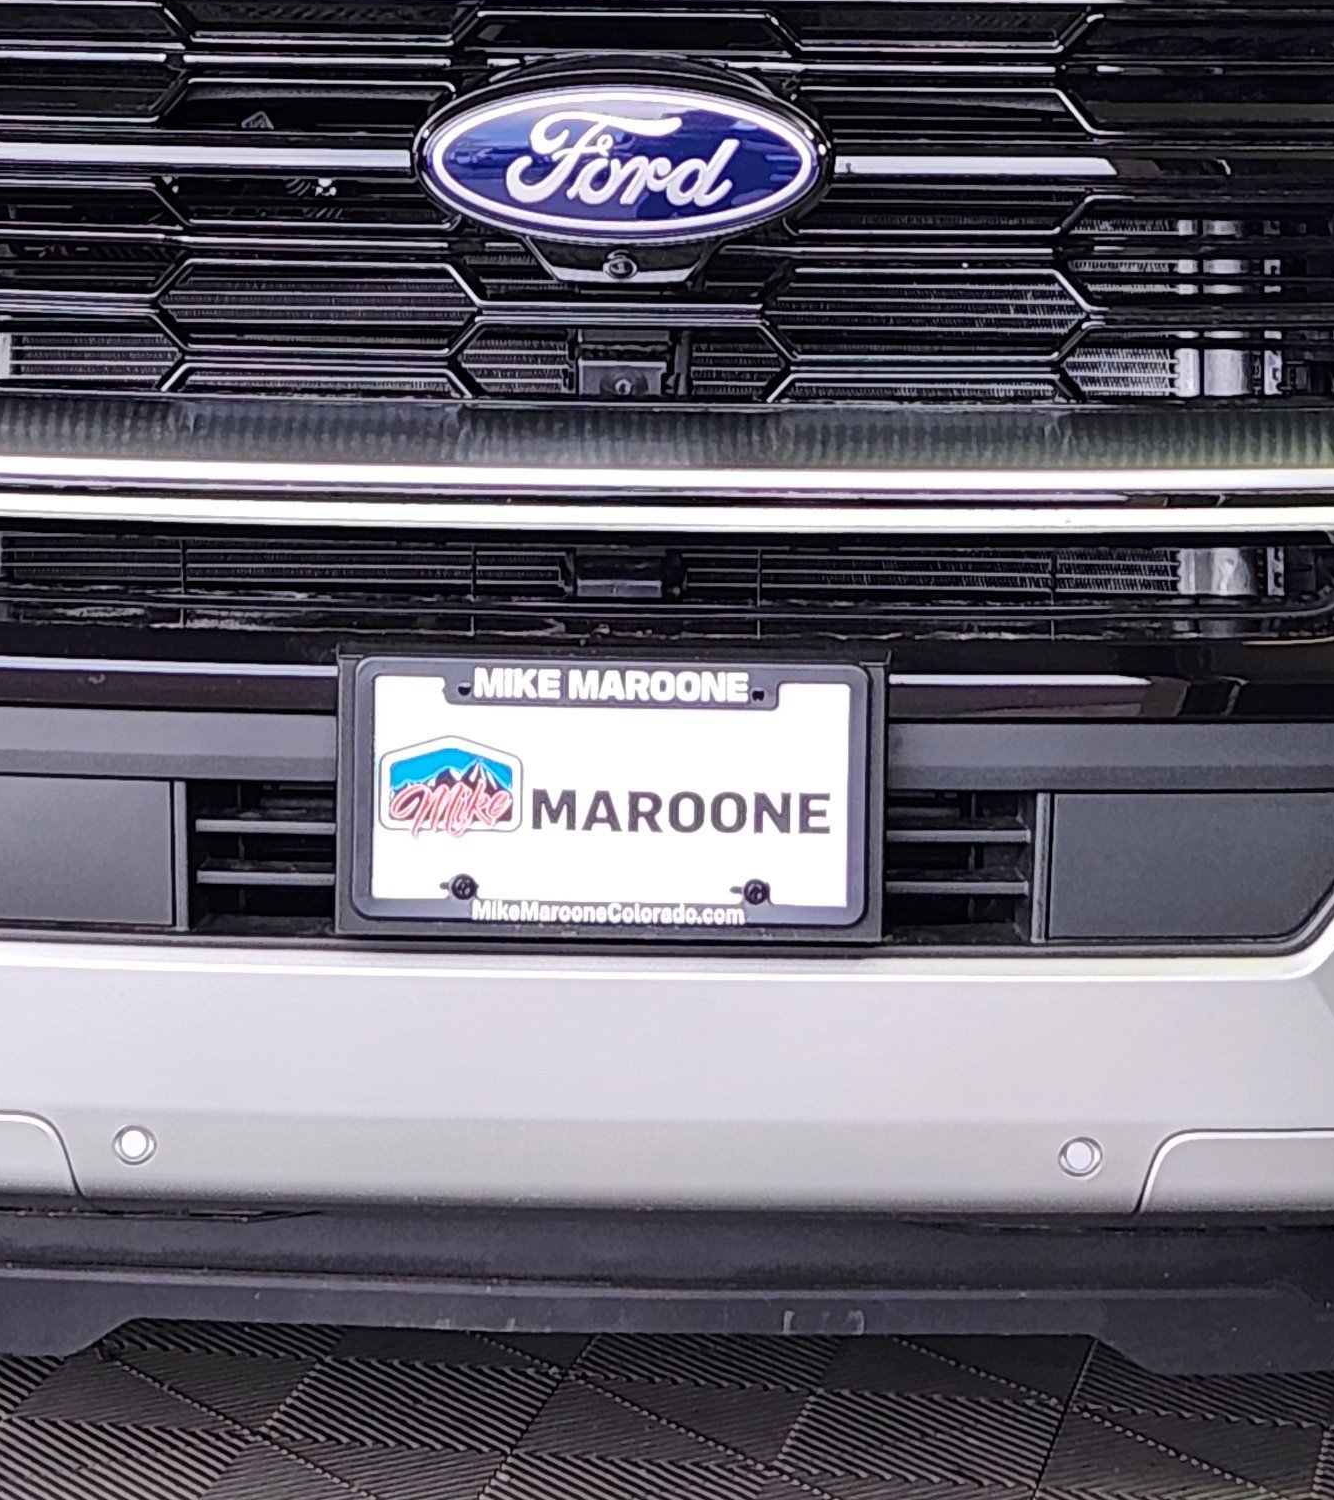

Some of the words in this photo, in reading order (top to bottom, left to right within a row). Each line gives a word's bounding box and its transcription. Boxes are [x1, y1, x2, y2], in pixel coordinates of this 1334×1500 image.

[505, 111, 740, 207] Ford
[473, 666, 561, 699] MIKE
[568, 669, 749, 702] MAROONE
[390, 781, 514, 840] Mike
[532, 788, 831, 834] MAROONE
[471, 899, 746, 925] MikeMarooneColorado.com
